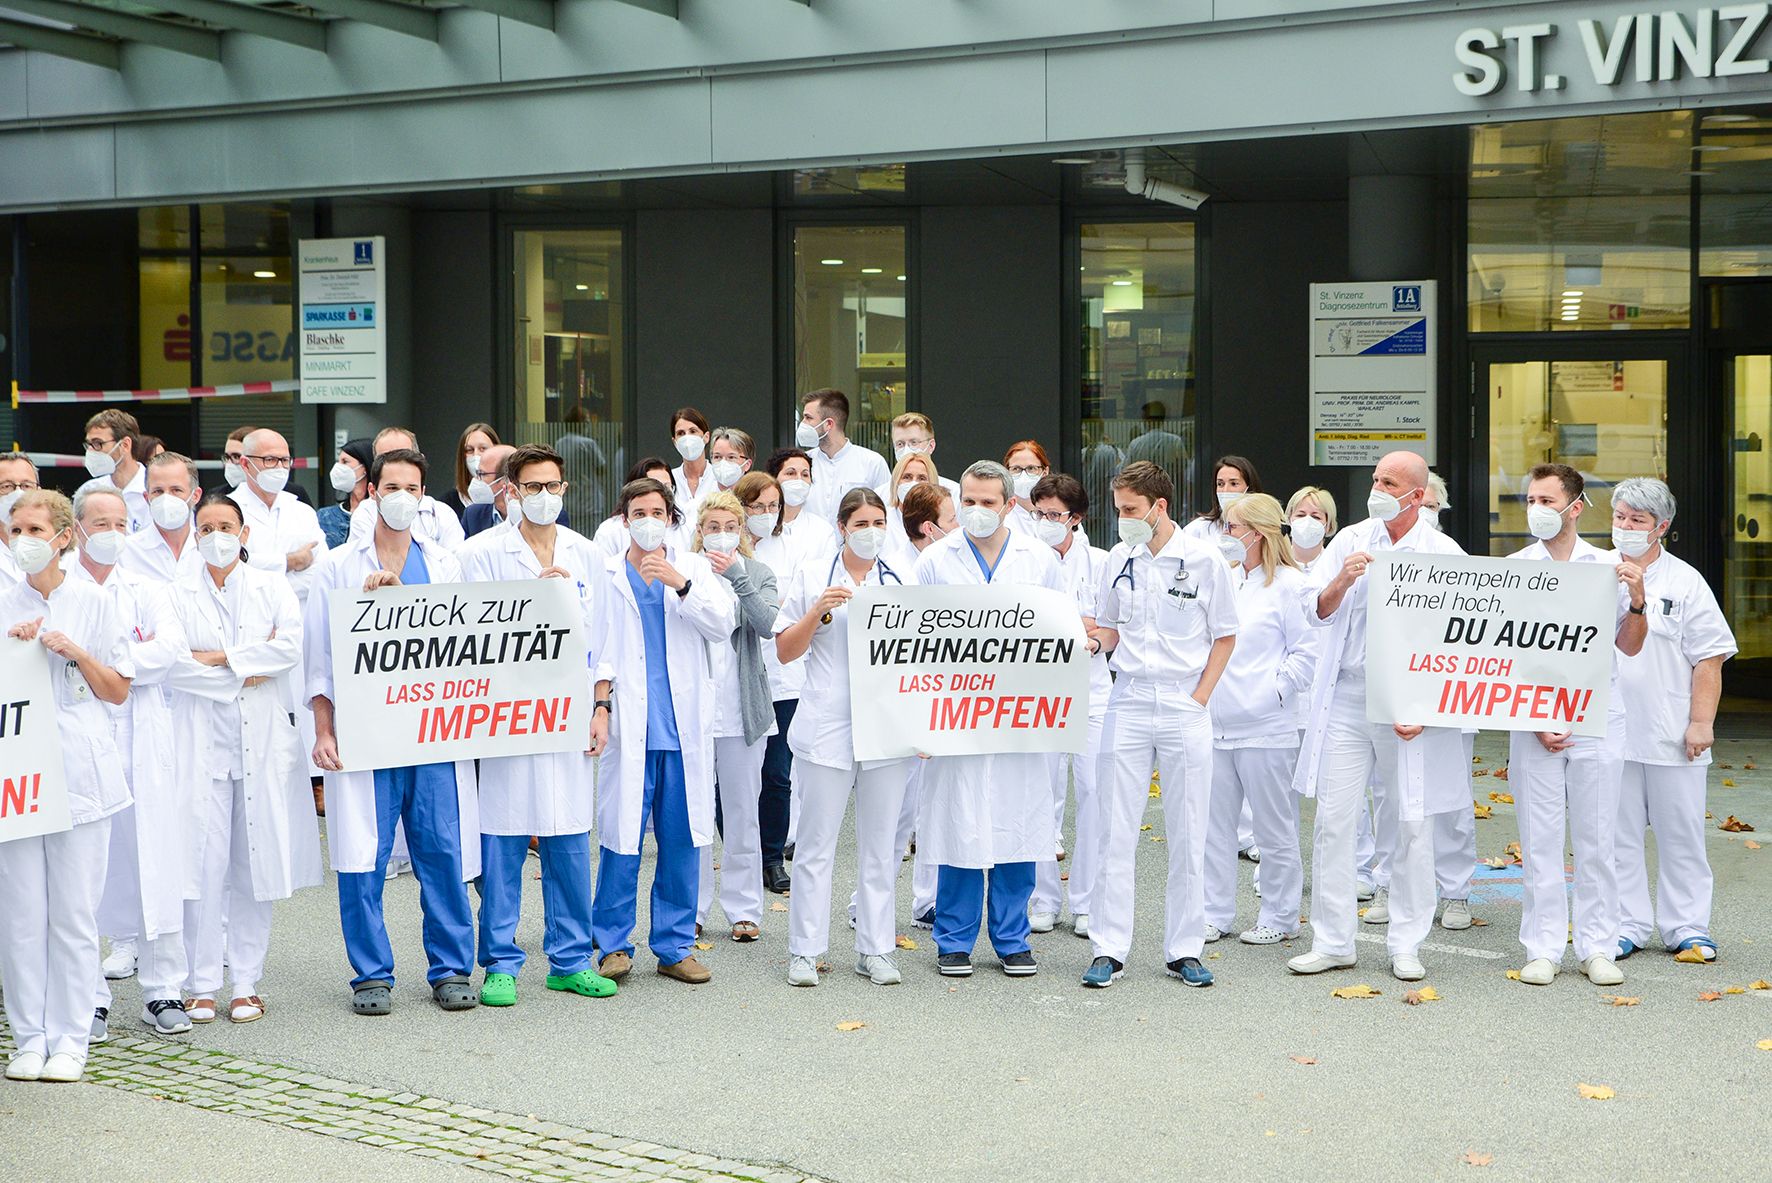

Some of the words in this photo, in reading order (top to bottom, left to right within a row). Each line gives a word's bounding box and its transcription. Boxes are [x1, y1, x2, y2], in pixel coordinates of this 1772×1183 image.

[1452, 23, 1565, 96] ST.
[1577, 2, 1771, 86] VINZ
[1319, 291, 1331, 300] St.
[1333, 291, 1364, 300] Vinzenz
[1319, 301, 1388, 312] Diagnosezentrum
[1397, 288, 1416, 303] 1A
[306, 311, 346, 322] SPARKASSE
[306, 333, 345, 345] Blaschke
[305, 360, 352, 372] MINIMARKT
[330, 384, 366, 396] VINZENZ
[1402, 416, 1421, 424] Stock
[1389, 562, 1422, 583] Wir
[1427, 565, 1521, 591] krempeln
[1527, 571, 1559, 592] die
[350, 594, 469, 633] Zurück
[477, 598, 532, 624] zur
[1386, 585, 1447, 610] Ärmel
[1452, 592, 1505, 616] hoch,
[867, 603, 913, 630] Für
[917, 602, 1035, 634] gesunde
[1443, 616, 1488, 645] DU
[1493, 620, 1598, 653] AUCH?
[354, 623, 570, 675] NORMALITÄT
[869, 638, 1074, 665] WEIHNACHTEN
[1408, 653, 1459, 673] LASS
[1464, 656, 1513, 677] DICH
[385, 682, 435, 705] LASS
[442, 678, 491, 700] DICH
[898, 674, 944, 693] LASS
[950, 674, 996, 691] DICH
[929, 696, 1072, 731] IMPFEN!
[1437, 679, 1593, 723] IMPFEN!
[417, 697, 571, 744] IMPFEN!
